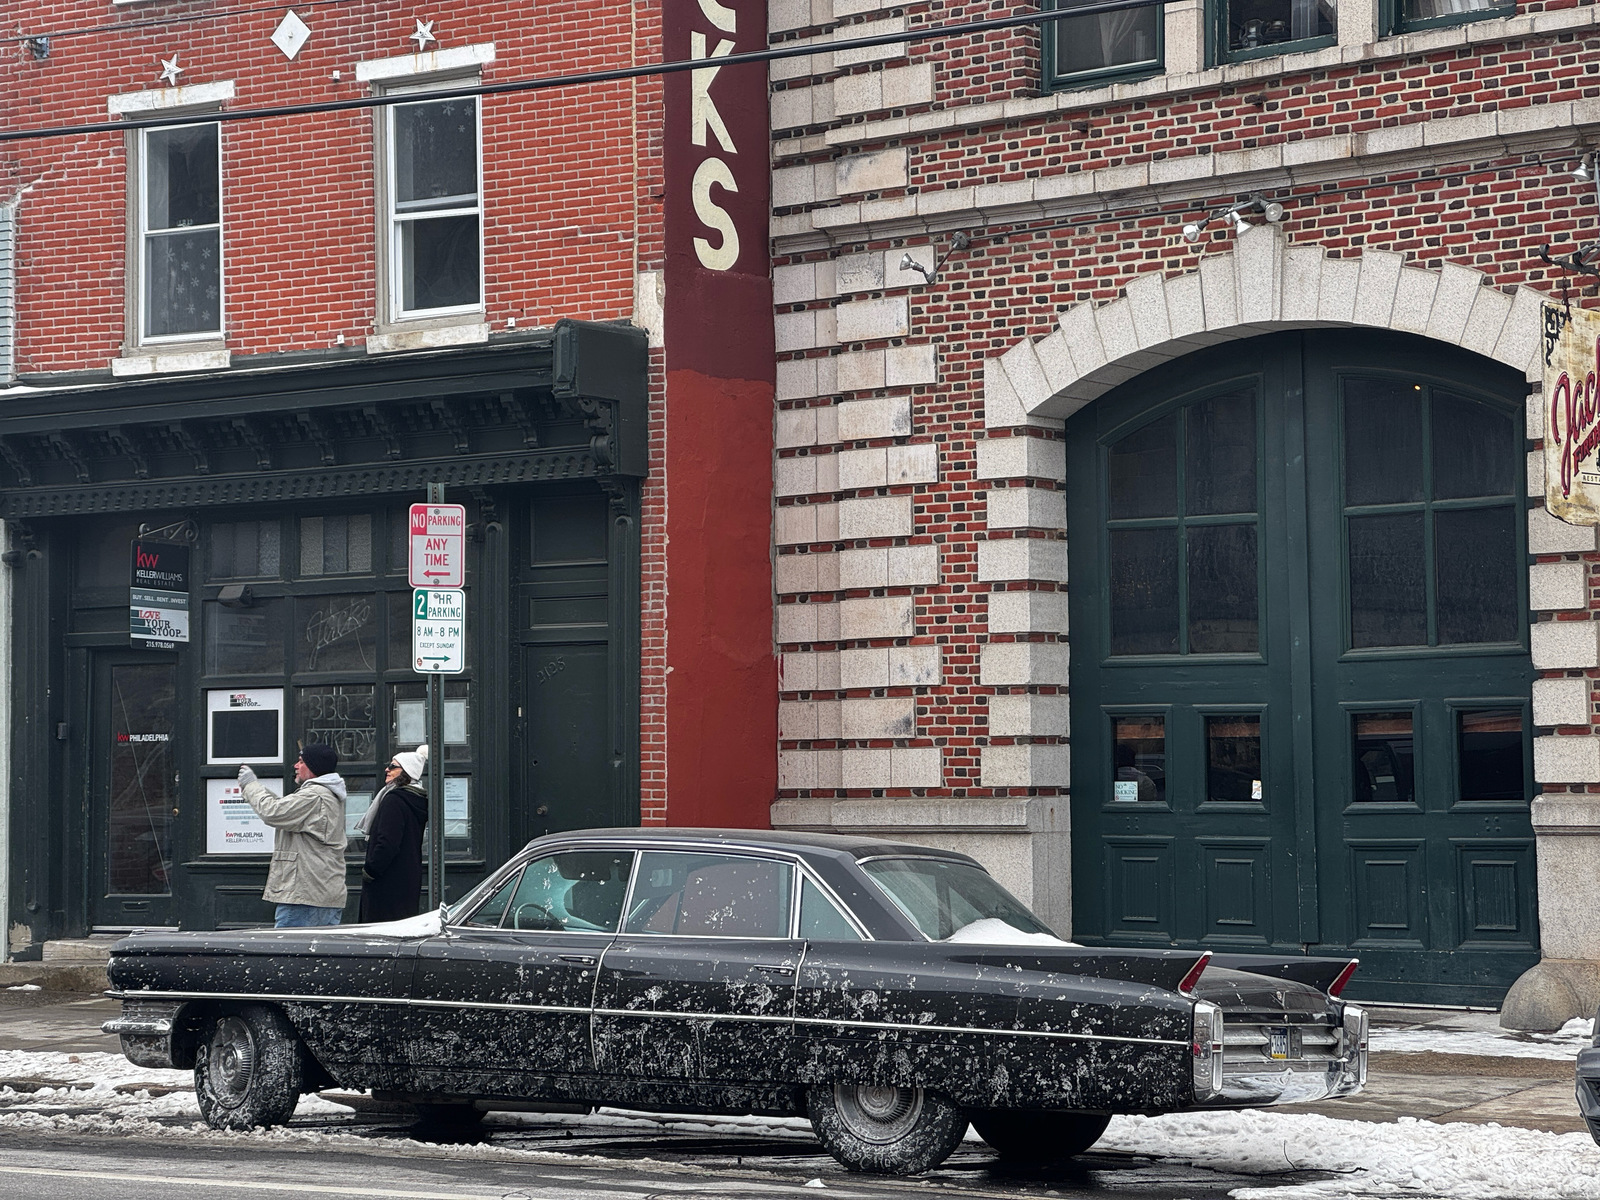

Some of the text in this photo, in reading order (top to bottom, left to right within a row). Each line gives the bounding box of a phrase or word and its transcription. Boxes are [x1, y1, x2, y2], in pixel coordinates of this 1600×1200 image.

[412, 513, 461, 528] NO PARKING
[425, 538, 448, 551] ANY
[136, 545, 159, 569] kw
[424, 553, 450, 566] TIME
[153, 579, 175, 587] ESTATE
[417, 594, 452, 615] 2 HR
[138, 609, 161, 620] LOVE
[428, 607, 461, 617] PARKING
[145, 618, 171, 630] YOUR
[417, 626, 422, 636] 8
[423, 626, 433, 637] AM
[448, 627, 460, 637] PM
[308, 693, 350, 721] BBQ
